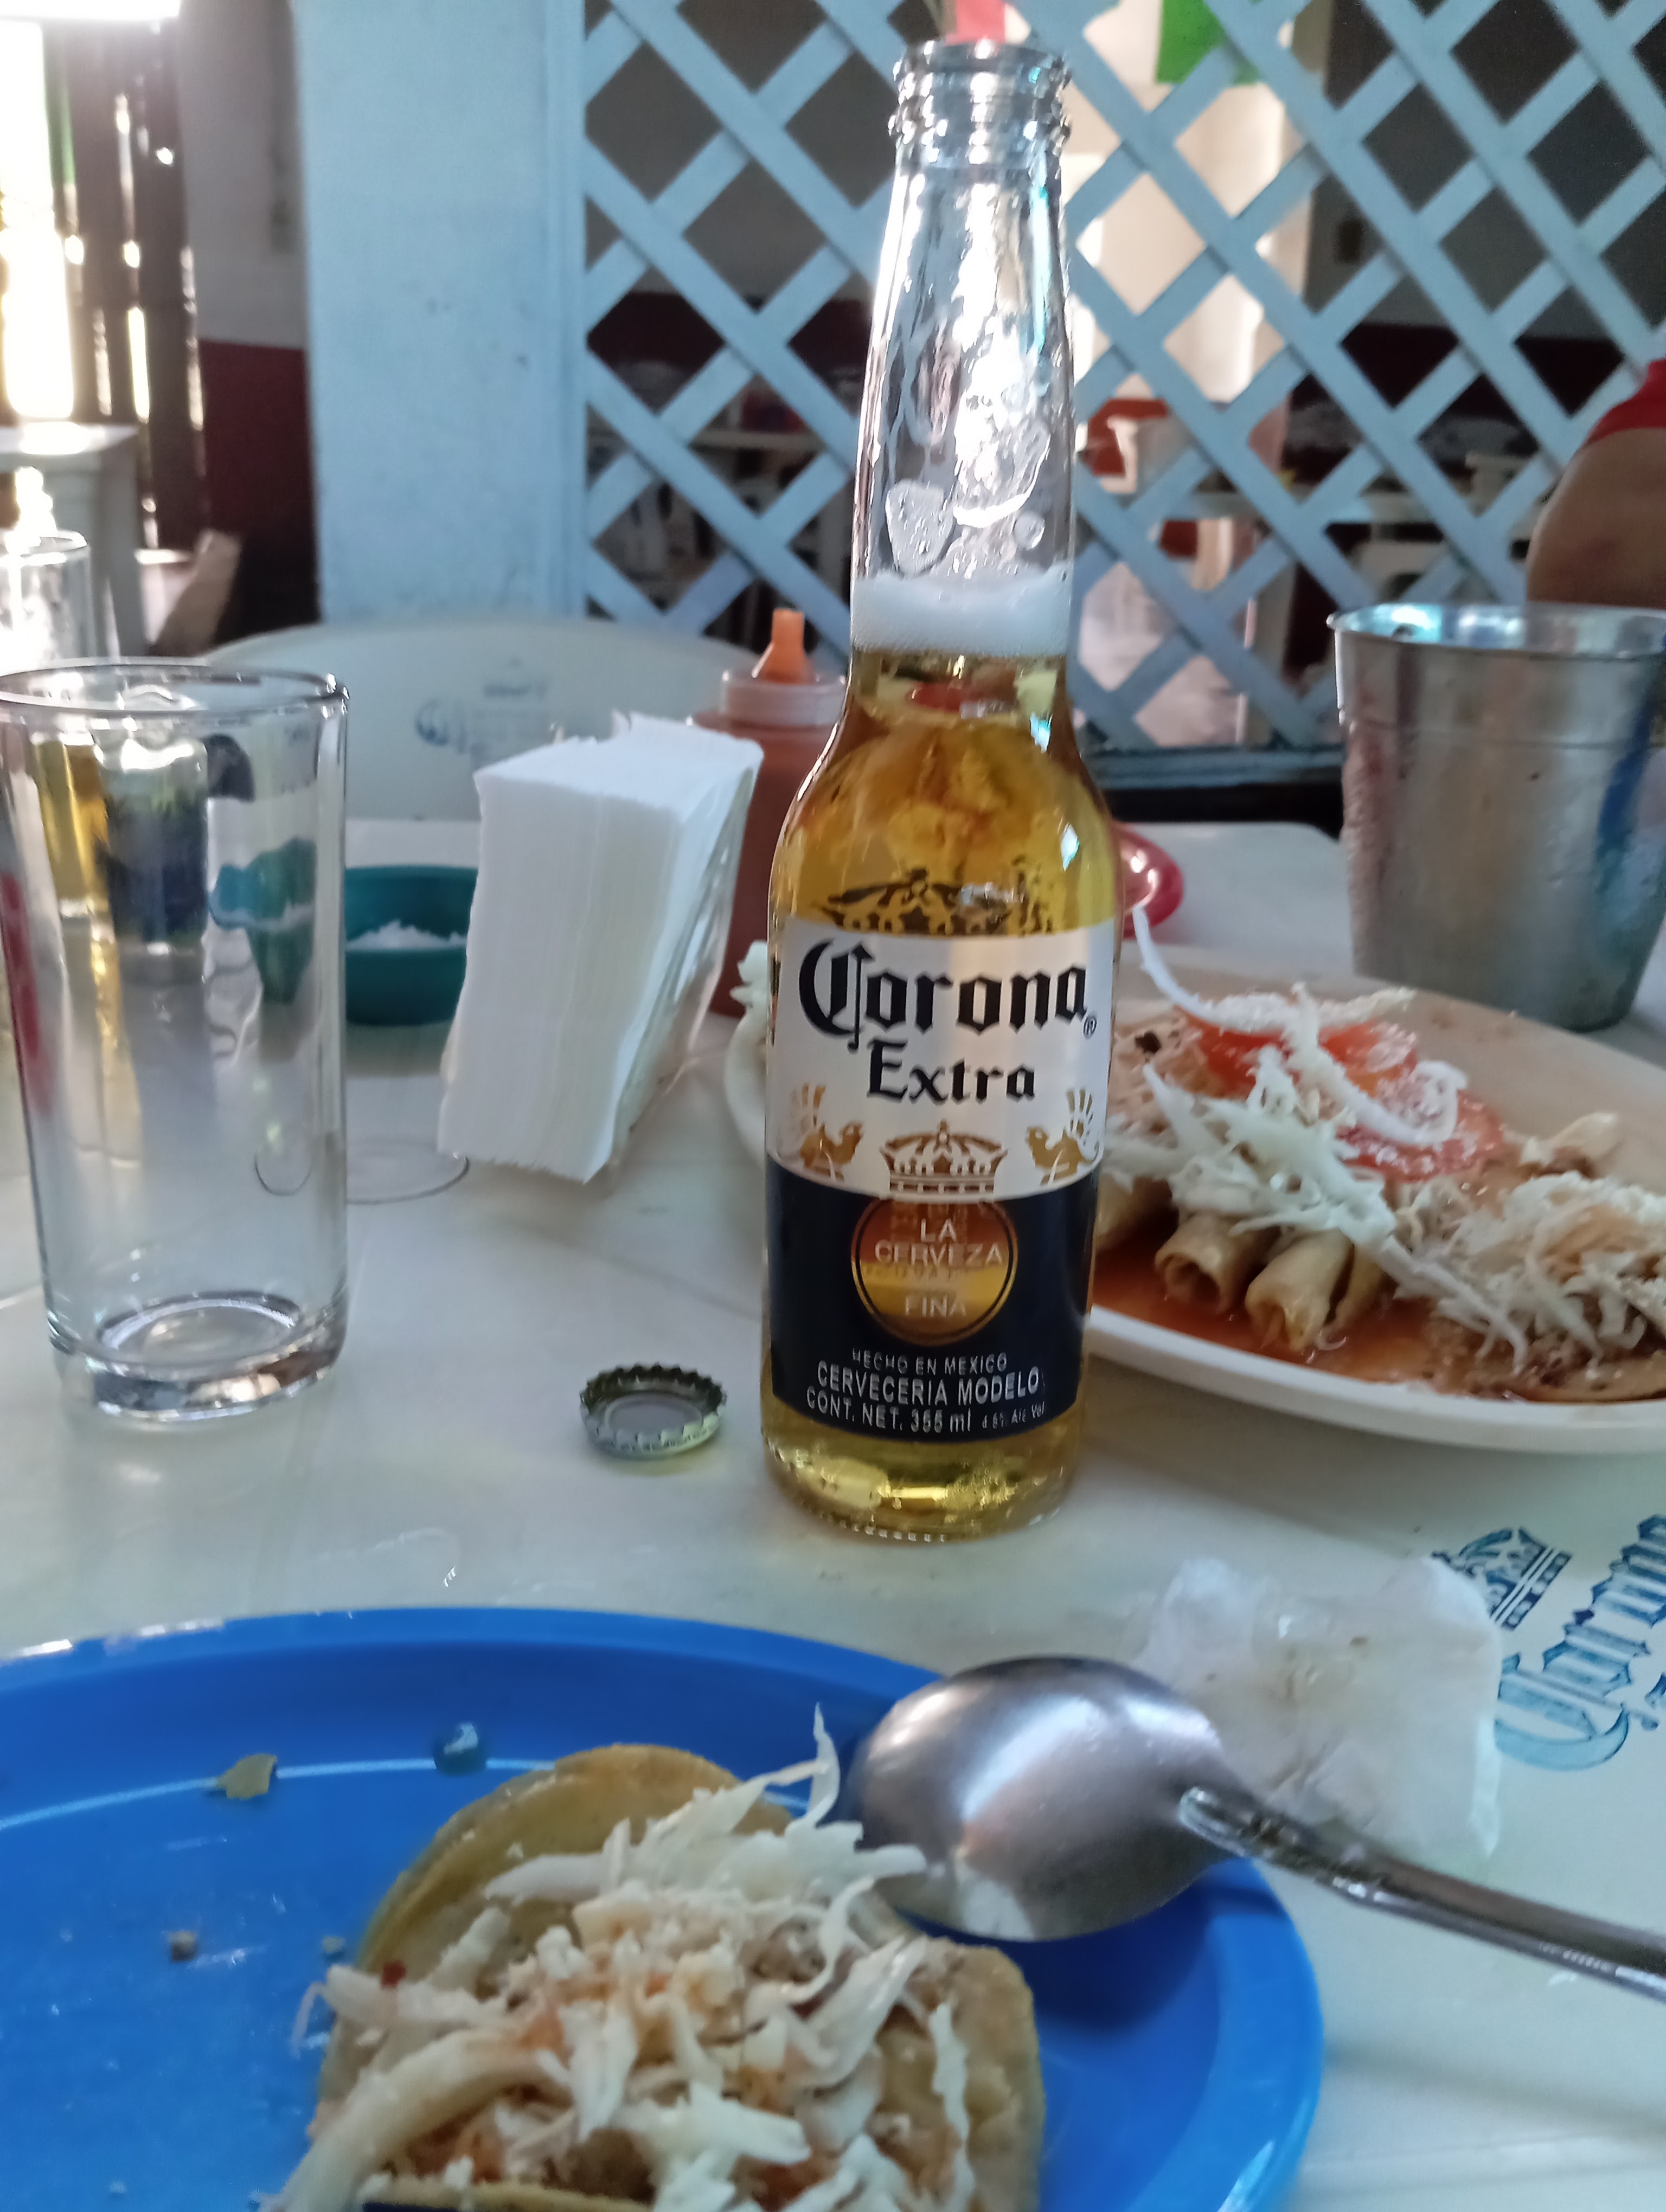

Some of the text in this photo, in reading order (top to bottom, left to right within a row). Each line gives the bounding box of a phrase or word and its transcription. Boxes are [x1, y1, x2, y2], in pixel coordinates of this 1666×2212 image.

[799, 939, 1088, 1053] Corona
[867, 1039, 1035, 1105] Extra
[874, 1239, 1003, 1266] CERVEZA
[920, 1218, 957, 1243] LA
[905, 1295, 966, 1317] FINA
[818, 1360, 1039, 1406] CERVECERIA MODELO
[852, 1348, 1007, 1375] HECHO EN MEXICO
[807, 1385, 855, 1422] CONT.
[863, 1403, 902, 1430] NET.
[950, 1408, 971, 1432] ml
[1494, 1515, 1666, 1770] Coron
